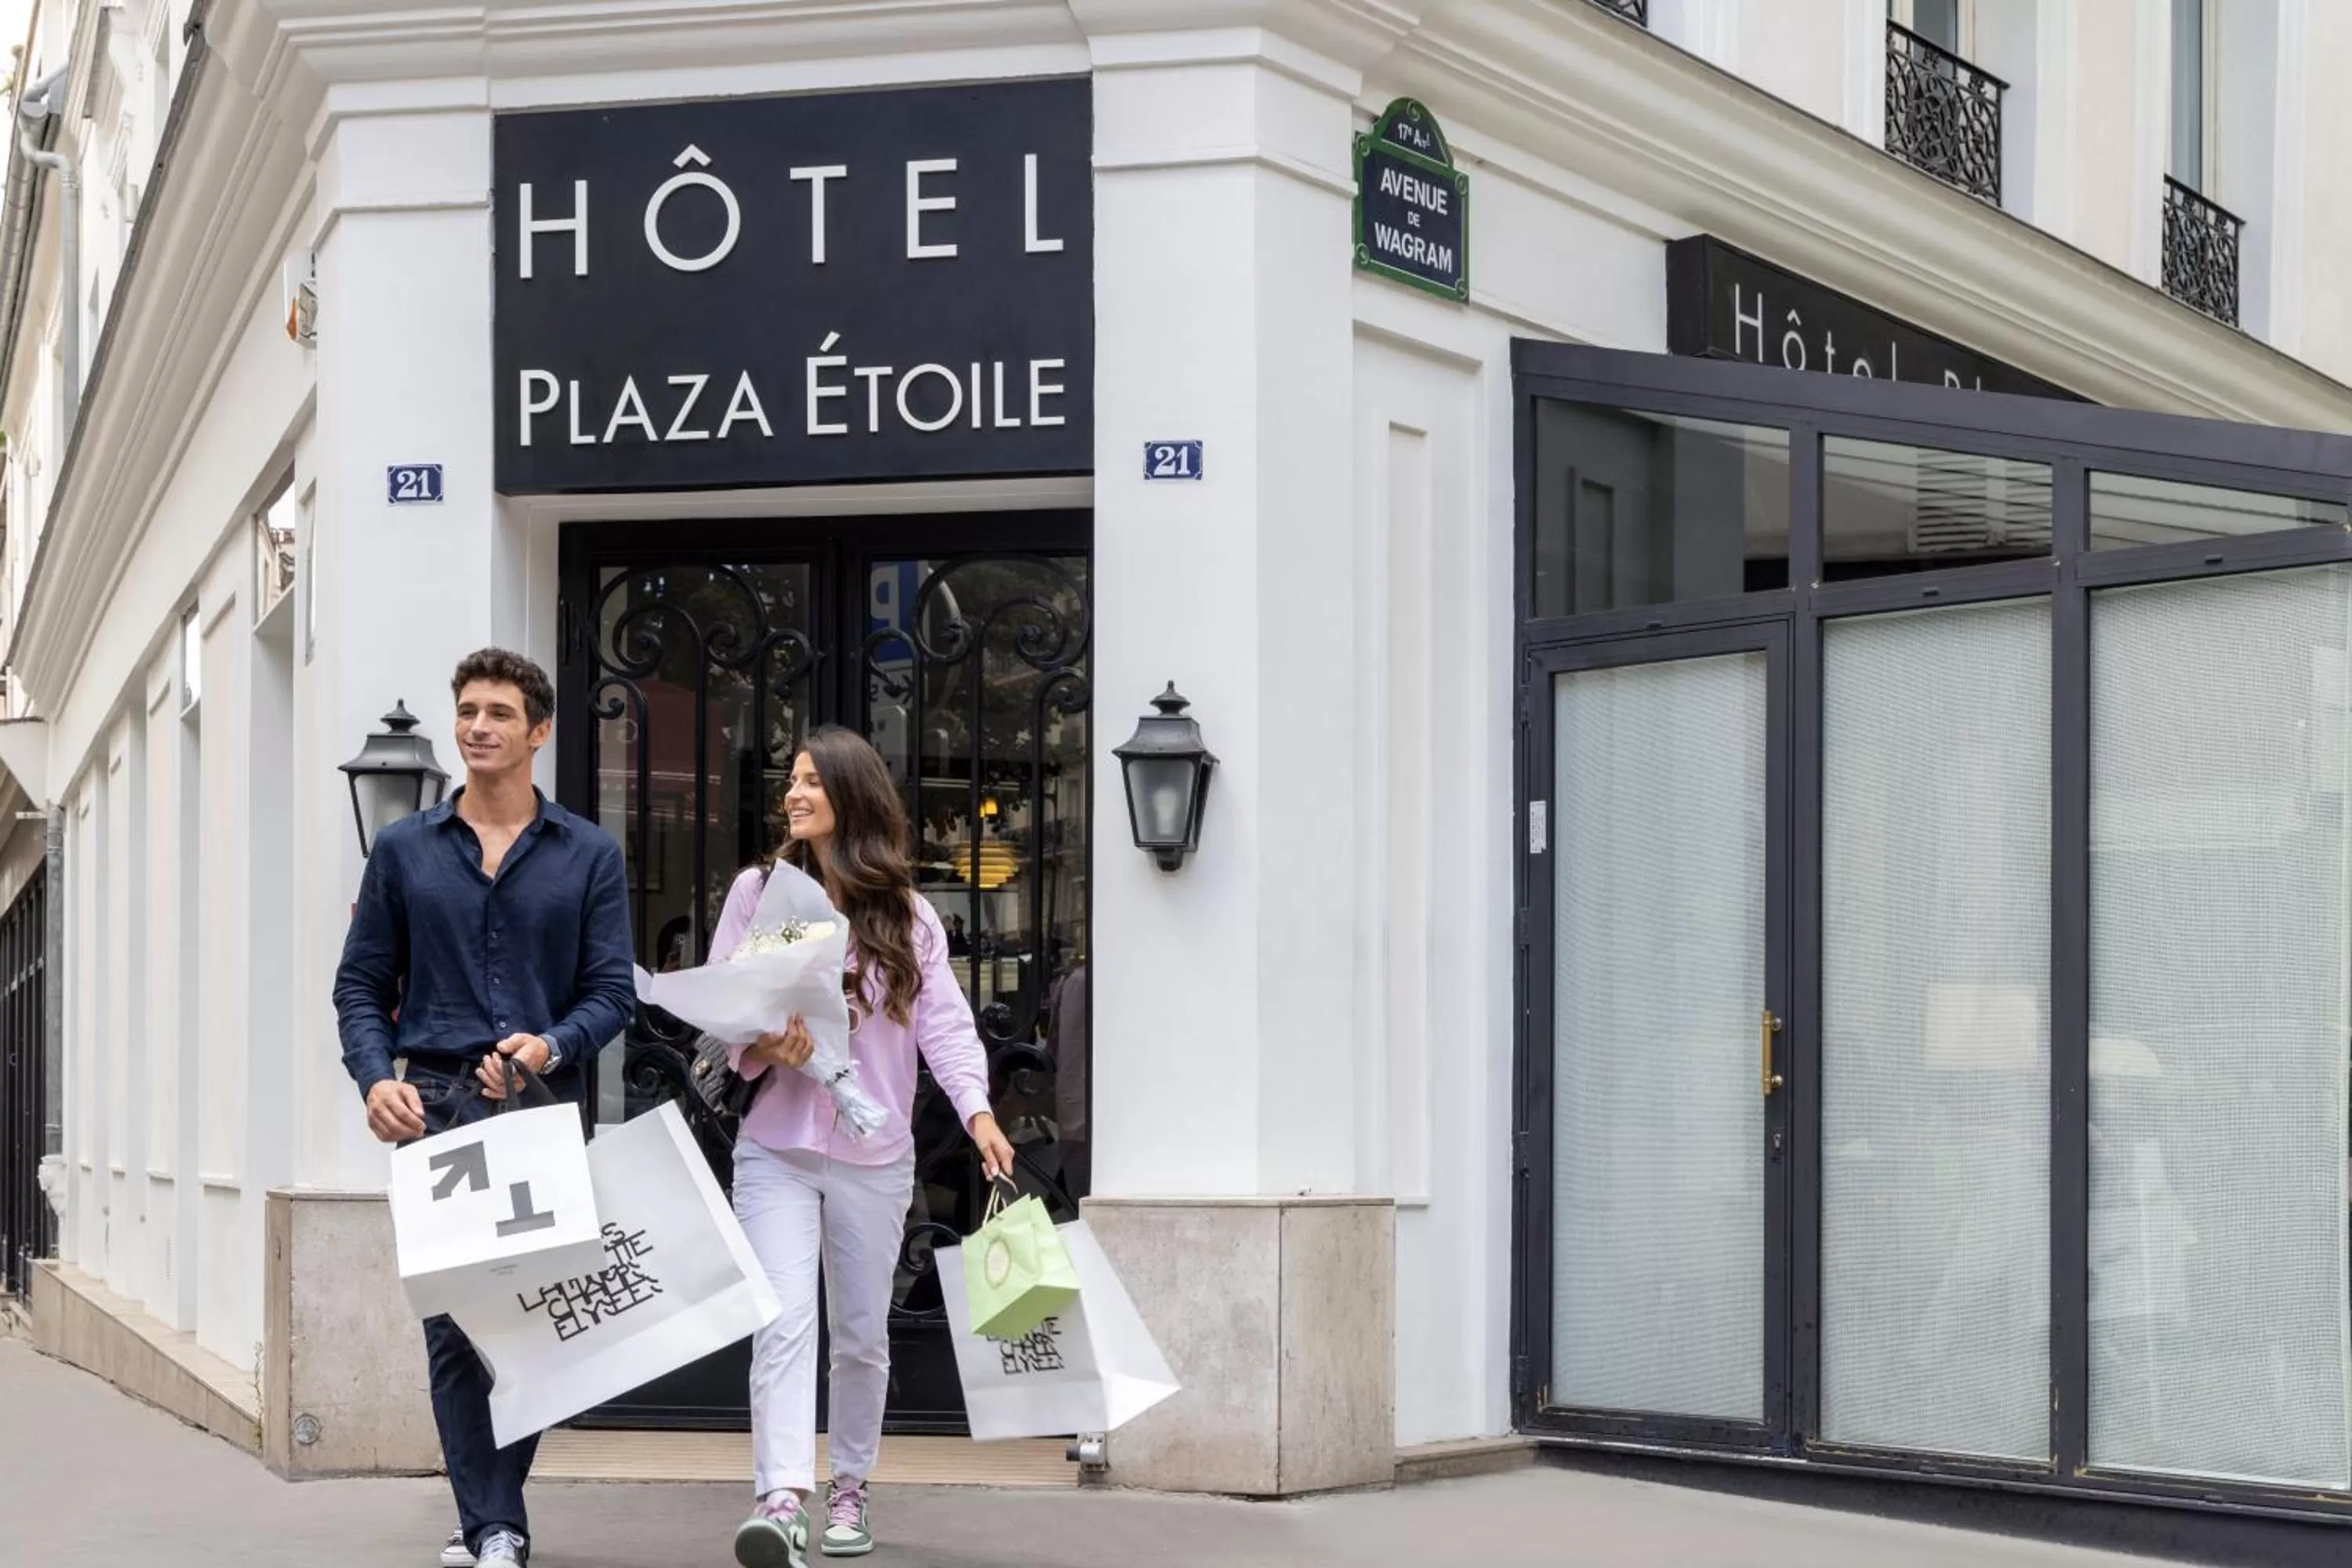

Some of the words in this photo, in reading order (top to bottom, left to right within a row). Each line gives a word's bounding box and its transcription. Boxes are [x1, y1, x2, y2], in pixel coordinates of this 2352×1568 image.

[518, 143, 1065, 280] HÔTEL
[1380, 167, 1448, 216] AVENUE
[1407, 210, 1421, 228] DE
[1374, 221, 1453, 274] WAGRAM
[519, 368, 774, 448] PLAZA
[805, 331, 1067, 437] ÉTOILE
[397, 470, 432, 498] 21
[1153, 445, 1191, 476] 21
